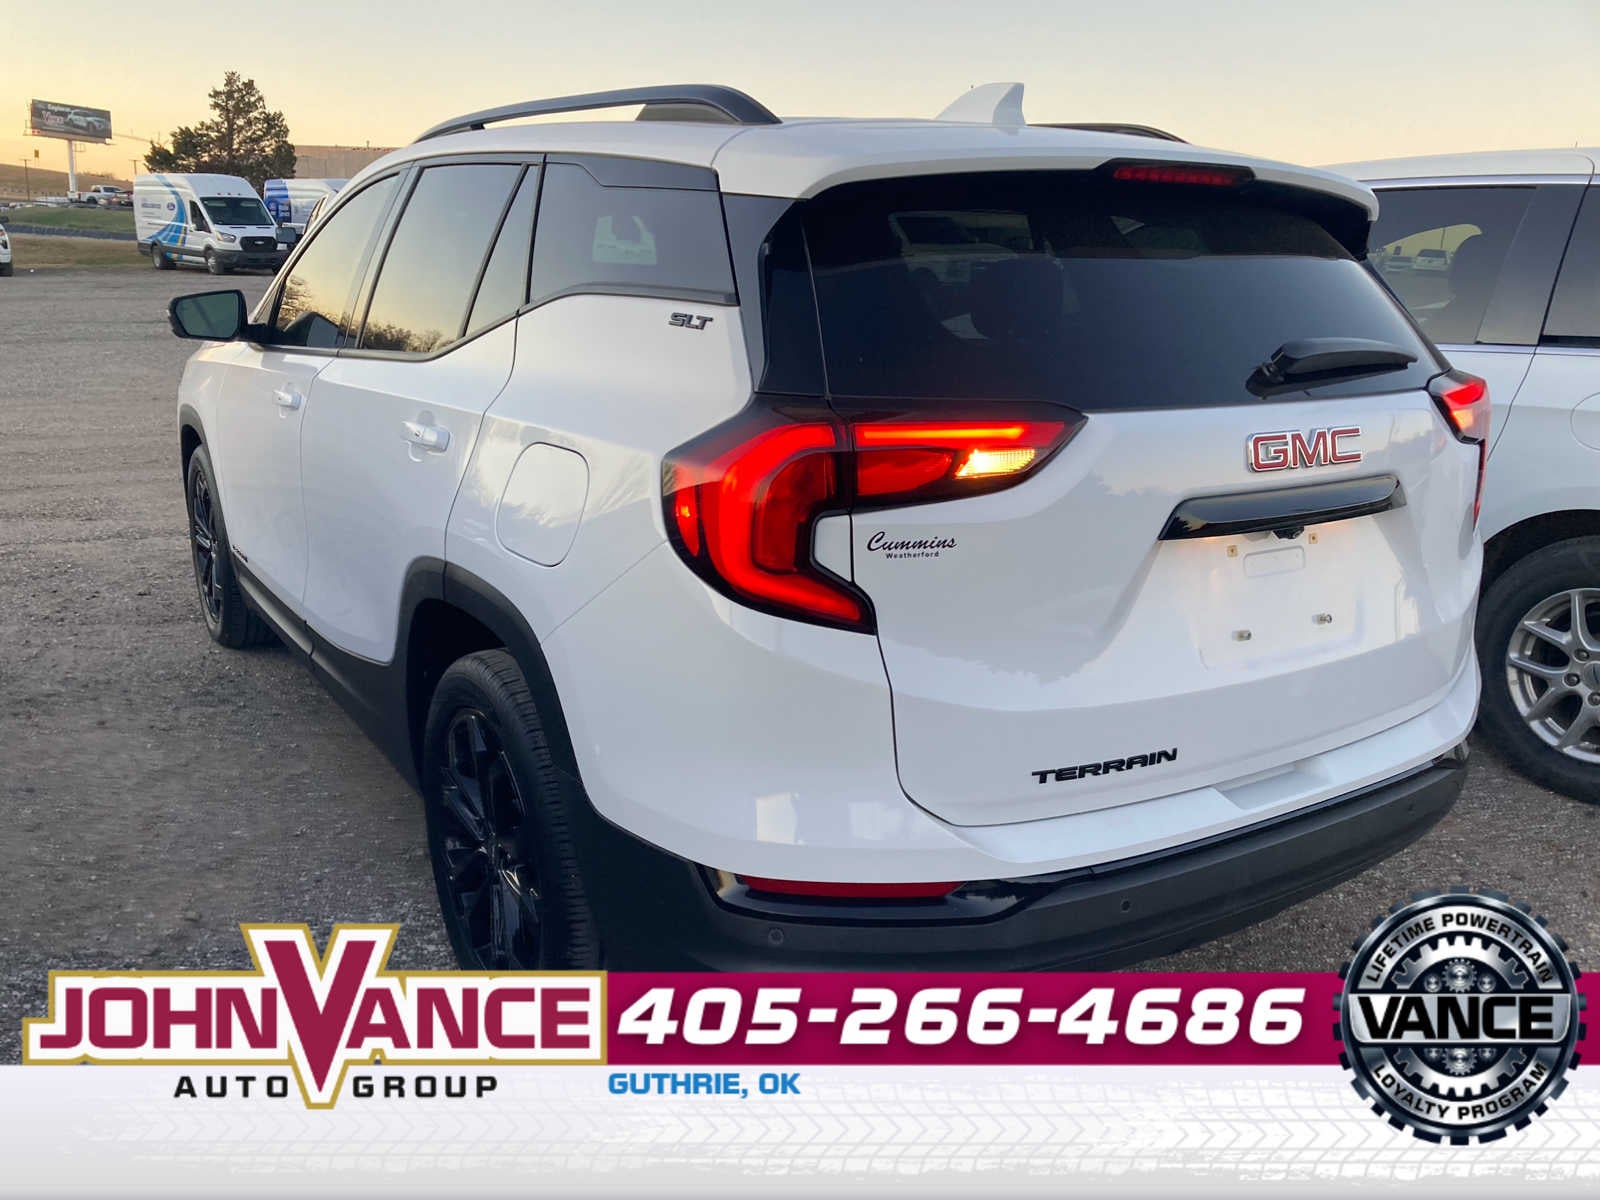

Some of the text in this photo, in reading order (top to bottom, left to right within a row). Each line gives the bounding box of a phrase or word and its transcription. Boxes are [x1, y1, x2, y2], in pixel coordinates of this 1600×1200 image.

[668, 312, 714, 330] SLT
[1247, 425, 1363, 473] GMC
[867, 531, 957, 552] Cummins
[886, 551, 939, 559] Weatherford
[1031, 747, 1178, 785] TERRAIN
